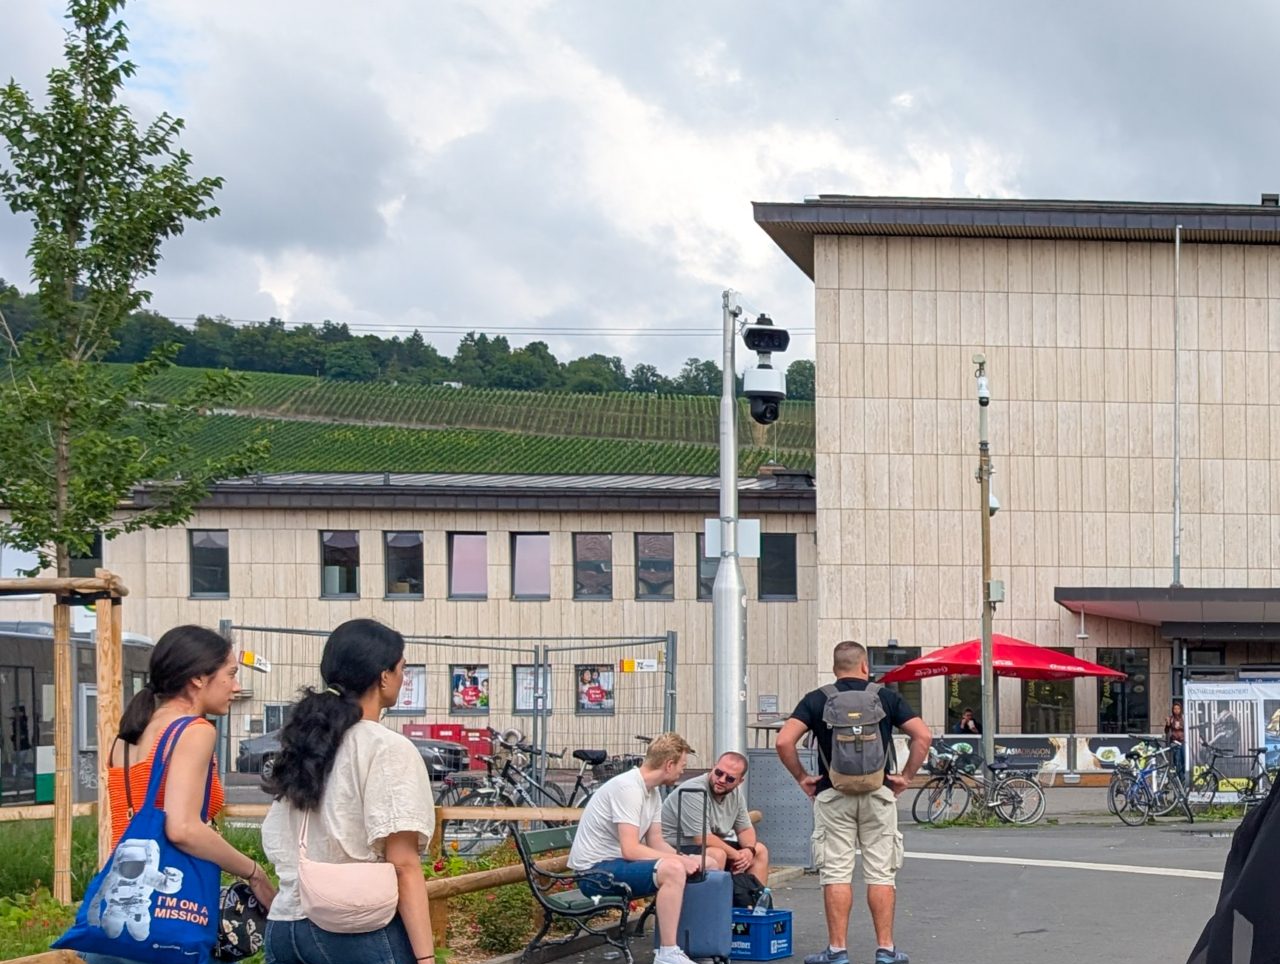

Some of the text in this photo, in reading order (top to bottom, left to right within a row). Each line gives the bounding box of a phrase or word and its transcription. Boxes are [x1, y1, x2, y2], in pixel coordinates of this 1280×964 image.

[157, 895, 209, 915] I'M ON A
[154, 907, 209, 926] MISSION
